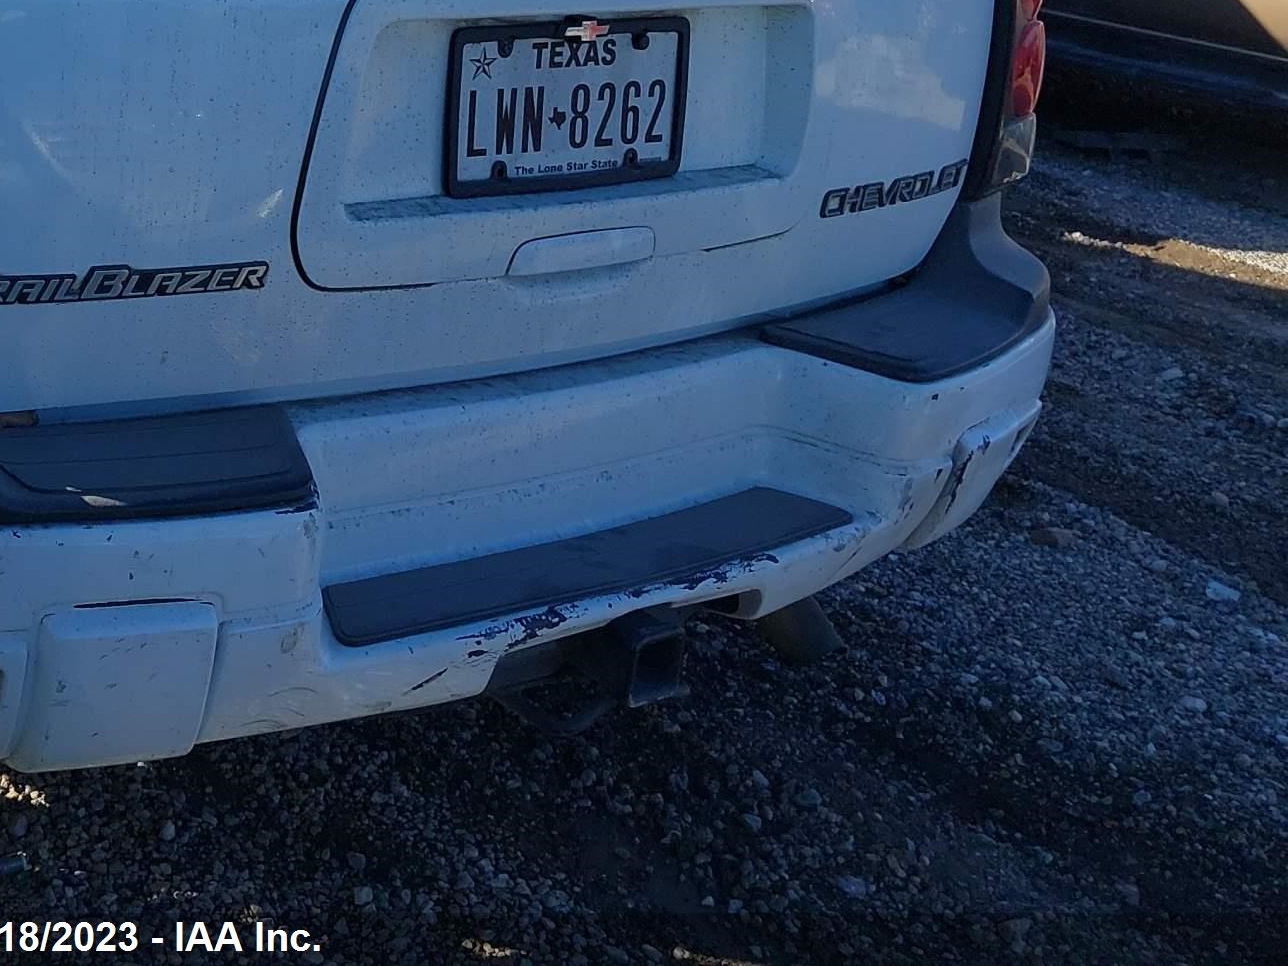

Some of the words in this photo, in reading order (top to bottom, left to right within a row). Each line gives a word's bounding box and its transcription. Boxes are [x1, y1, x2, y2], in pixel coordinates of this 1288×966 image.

[532, 39, 617, 70] TEXAS
[466, 85, 545, 158] LWN
[568, 78, 667, 149] 8262
[514, 166, 535, 176] The
[537, 163, 563, 174] Lone
[566, 161, 589, 172] Star
[590, 159, 618, 170] State
[819, 158, 968, 218] CHEVROLET
